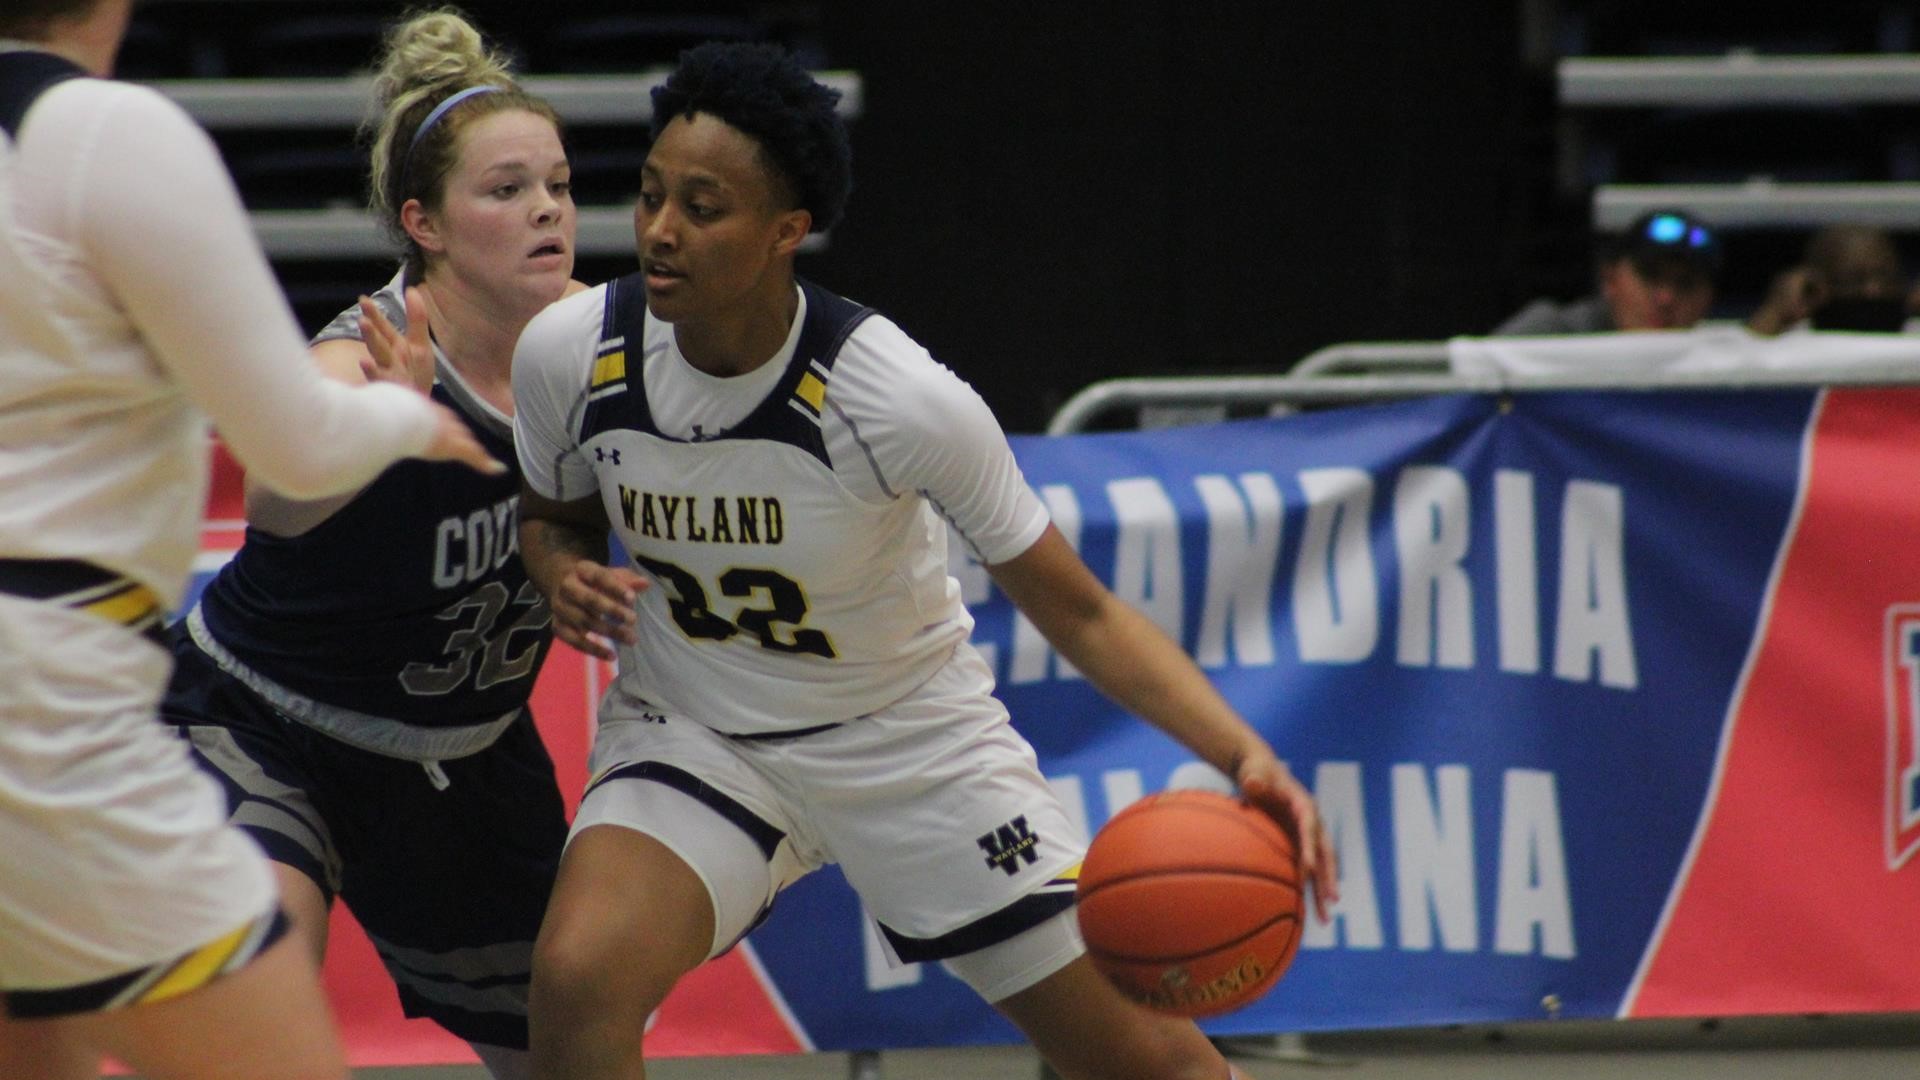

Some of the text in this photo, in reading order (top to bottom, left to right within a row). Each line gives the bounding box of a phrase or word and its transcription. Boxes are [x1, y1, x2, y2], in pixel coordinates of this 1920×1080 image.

[434, 496, 520, 588] COU
[618, 484, 785, 545] WAYLAND
[398, 580, 553, 696] 32
